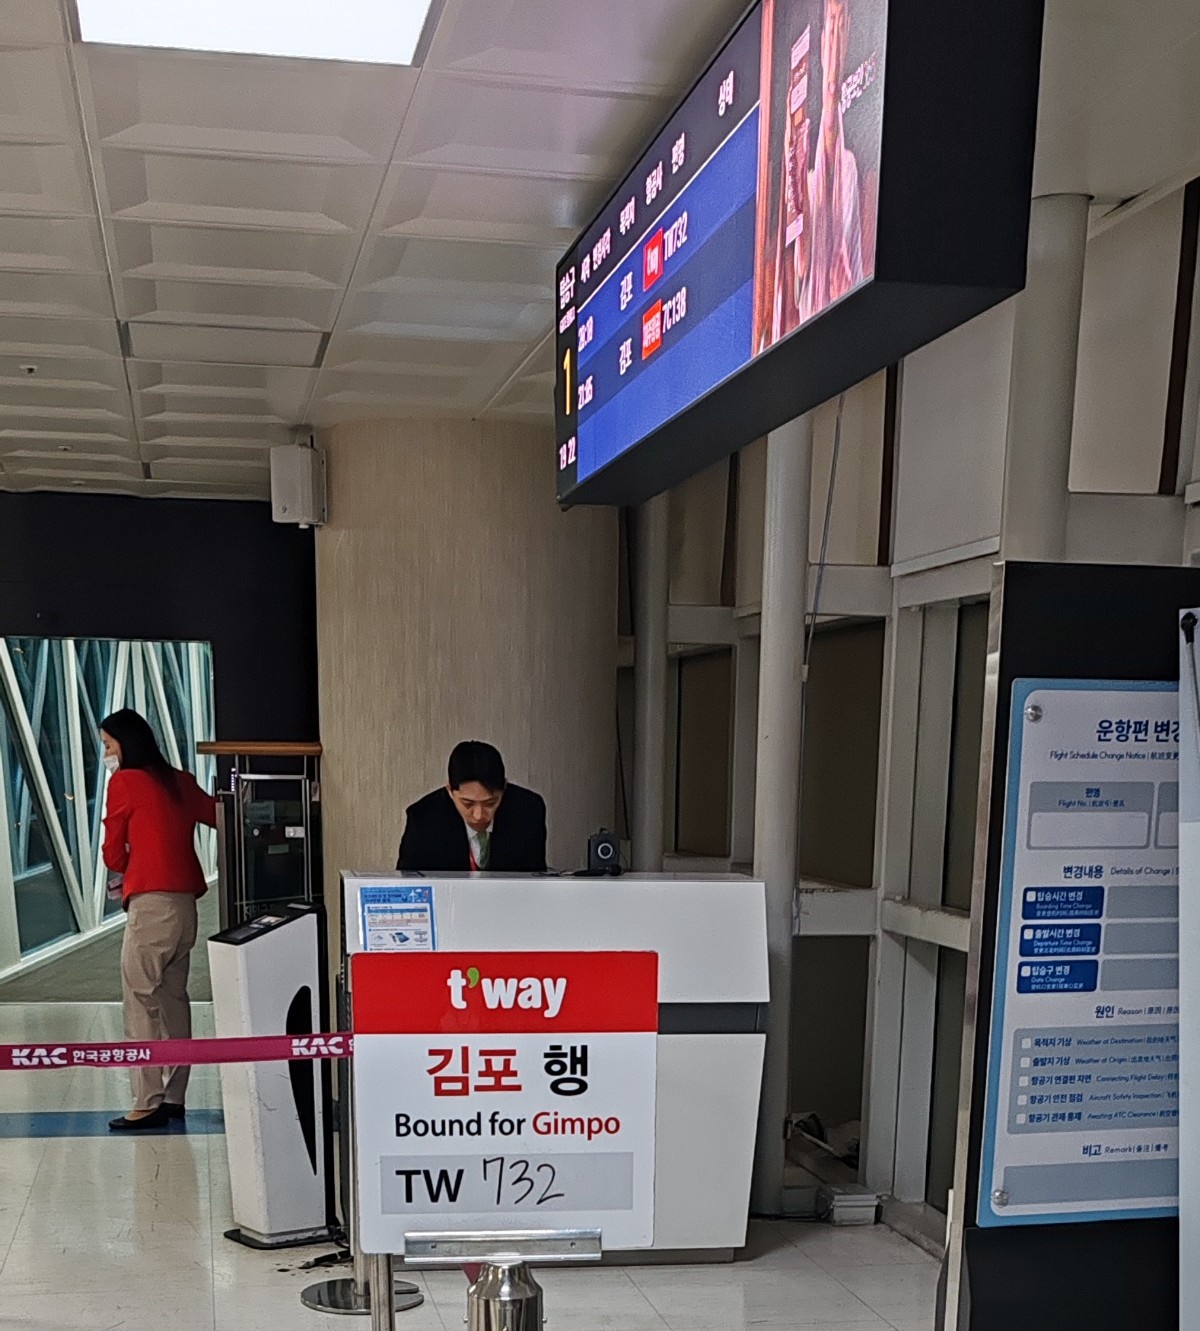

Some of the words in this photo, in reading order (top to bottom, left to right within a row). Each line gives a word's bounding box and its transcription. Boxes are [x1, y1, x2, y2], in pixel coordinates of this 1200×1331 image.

[718, 70, 734, 117] 상태
[620, 271, 633, 311] 김포
[664, 210, 688, 261] TW732
[560, 266, 576, 310] 탑승구
[619, 338, 632, 376] 김포
[662, 286, 687, 333] 7C138
[563, 348, 571, 416] 1
[1096, 719, 1149, 742] 운항편
[1050, 751, 1068, 761] Flight
[1070, 751, 1098, 759] Schedule
[1100, 751, 1124, 761] Change
[1126, 751, 1146, 759] Notice
[1058, 800, 1077, 808] Flight
[1063, 865, 1104, 878] 변경내용
[1110, 867, 1134, 875] Details
[1135, 867, 1142, 875] of
[1144, 866, 1170, 877] Change
[1037, 891, 1067, 901] 탑승시간
[1068, 891, 1083, 901] 변경
[1035, 929, 1064, 938] 출발시간
[1066, 929, 1080, 938] 변경
[1032, 965, 1054, 976] 탑승구
[1055, 965, 1070, 975] 변경
[447, 967, 567, 1018] t'way
[1094, 1005, 1115, 1018] 원인
[290, 1036, 344, 1056] KAC
[1034, 1037, 1056, 1047] 목적지
[1057, 1037, 1072, 1047] 기상
[1110, 1036, 1143, 1045] Destination
[11, 1048, 67, 1065] KAC
[72, 1048, 151, 1063] 한국공항공사
[1108, 1056, 1127, 1065] Origin
[1032, 1057, 1054, 1067] 출발지
[1056, 1056, 1071, 1066] 기상
[426, 1045, 522, 1097] 김포
[543, 1044, 589, 1097] 행
[1031, 1075, 1053, 1085] 항공기
[1077, 1074, 1092, 1084] 지연
[1096, 1075, 1129, 1083] Connecting
[1130, 1073, 1146, 1082] Flight
[1148, 1073, 1164, 1082] Delay
[1029, 1094, 1051, 1104] 항공기
[1112, 1093, 1131, 1102] Safety
[1132, 1092, 1162, 1101] Inspection
[1028, 1113, 1050, 1123] 항공기
[1114, 1111, 1126, 1119] ATC
[1127, 1110, 1156, 1119] Clearance
[394, 1111, 482, 1138] Bound
[489, 1111, 526, 1137] for
[532, 1111, 621, 1141] Gimpo
[1082, 1144, 1101, 1156] 비고
[1105, 1146, 1132, 1154] Remark
[395, 1168, 465, 1203] TW
[482, 1156, 565, 1206] 732
